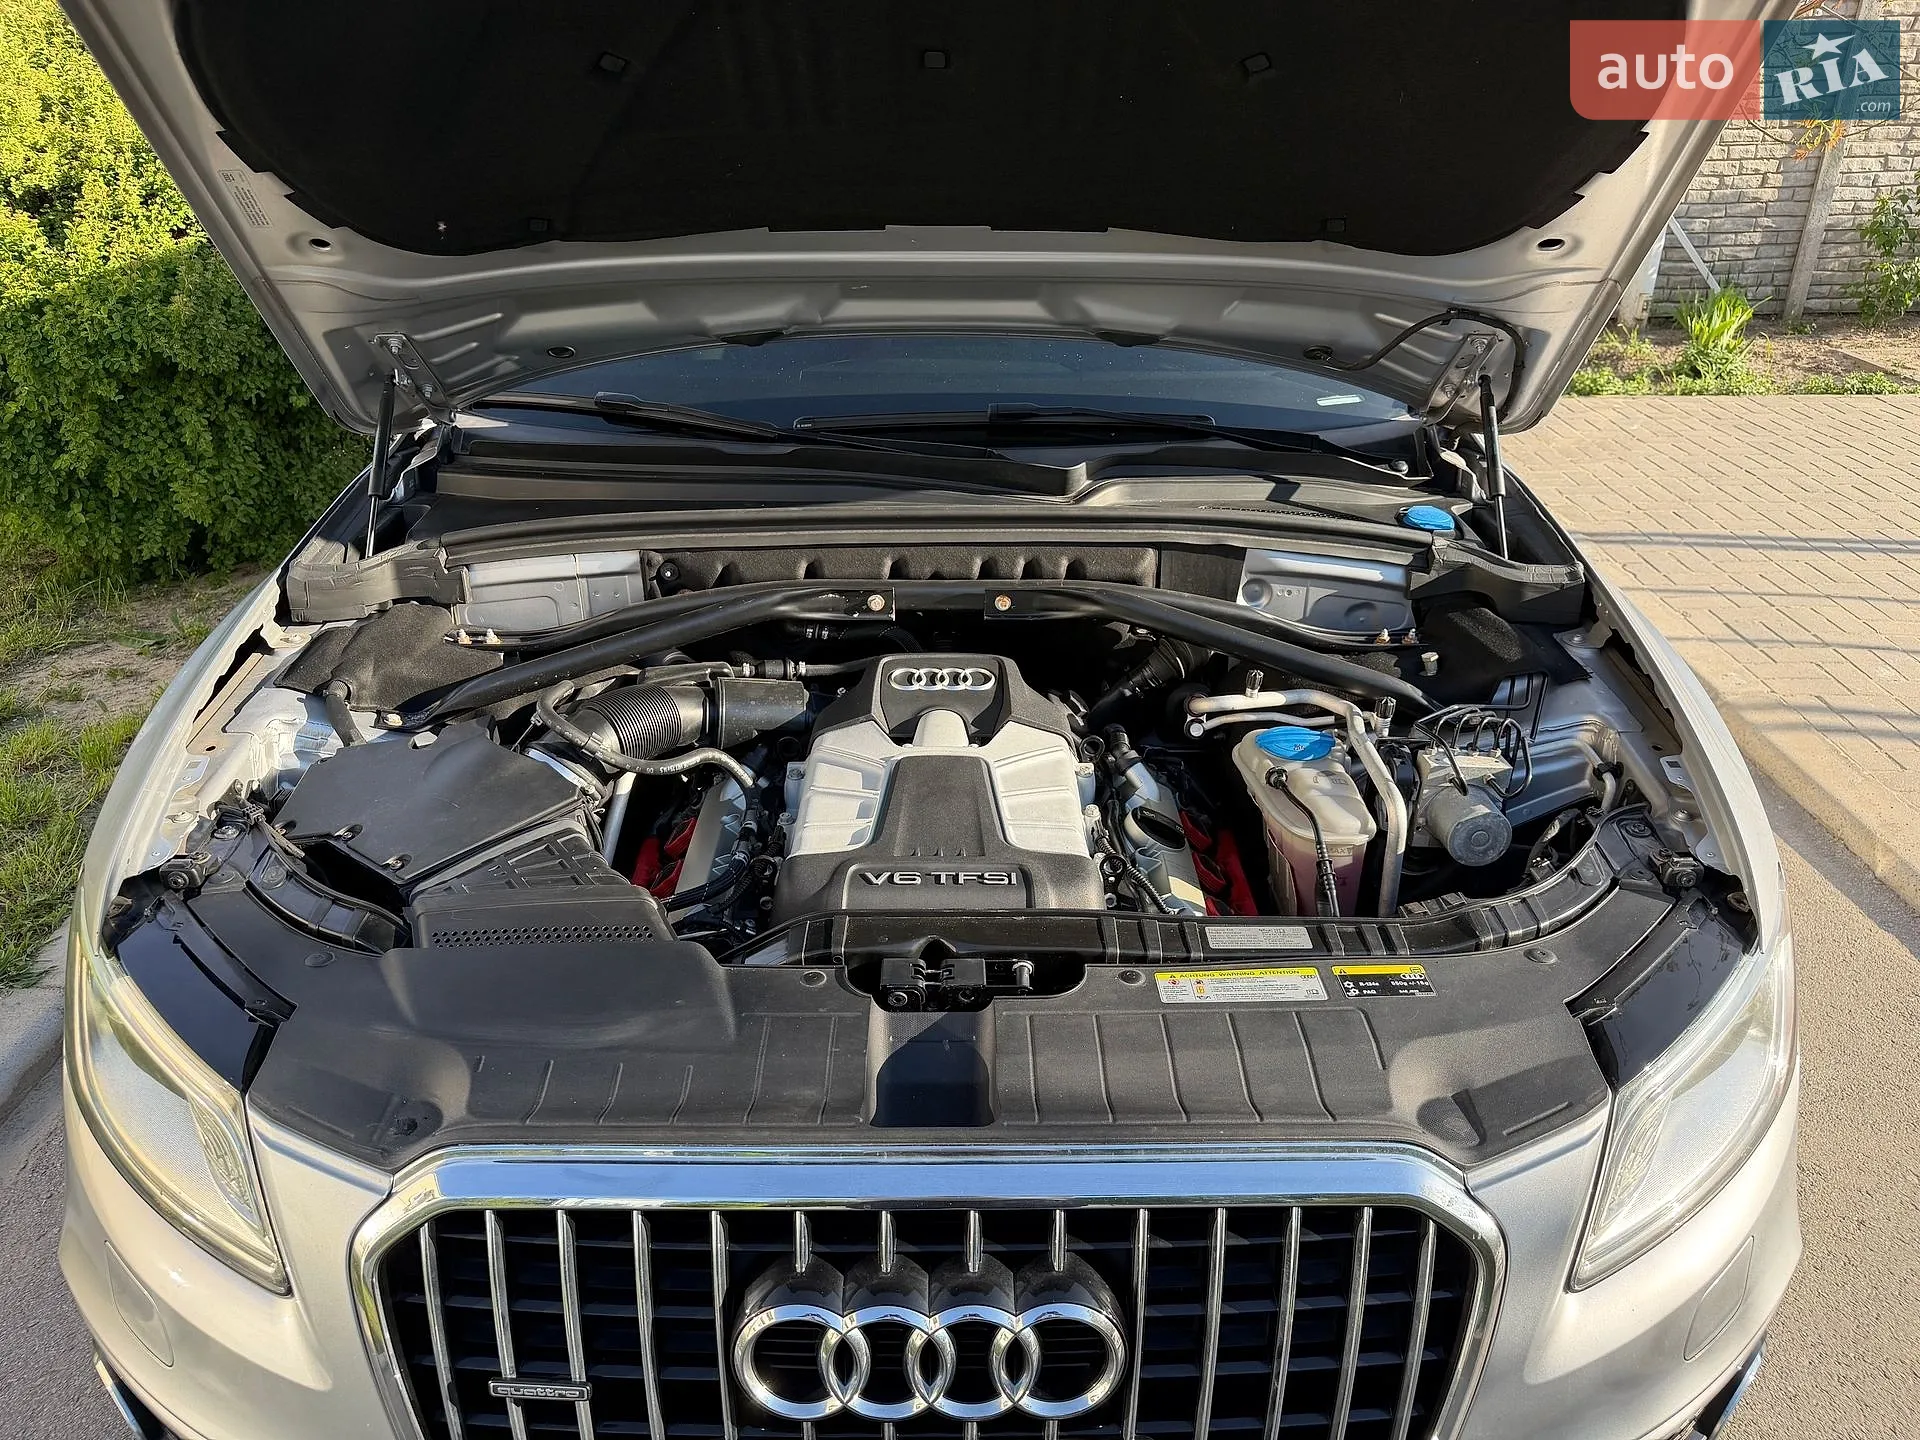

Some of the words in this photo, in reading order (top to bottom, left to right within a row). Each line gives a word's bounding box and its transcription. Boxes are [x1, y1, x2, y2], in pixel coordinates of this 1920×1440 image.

[861, 871, 922, 886] V6
[928, 871, 1018, 886] TFSI
[497, 1386, 580, 1398] quattro
